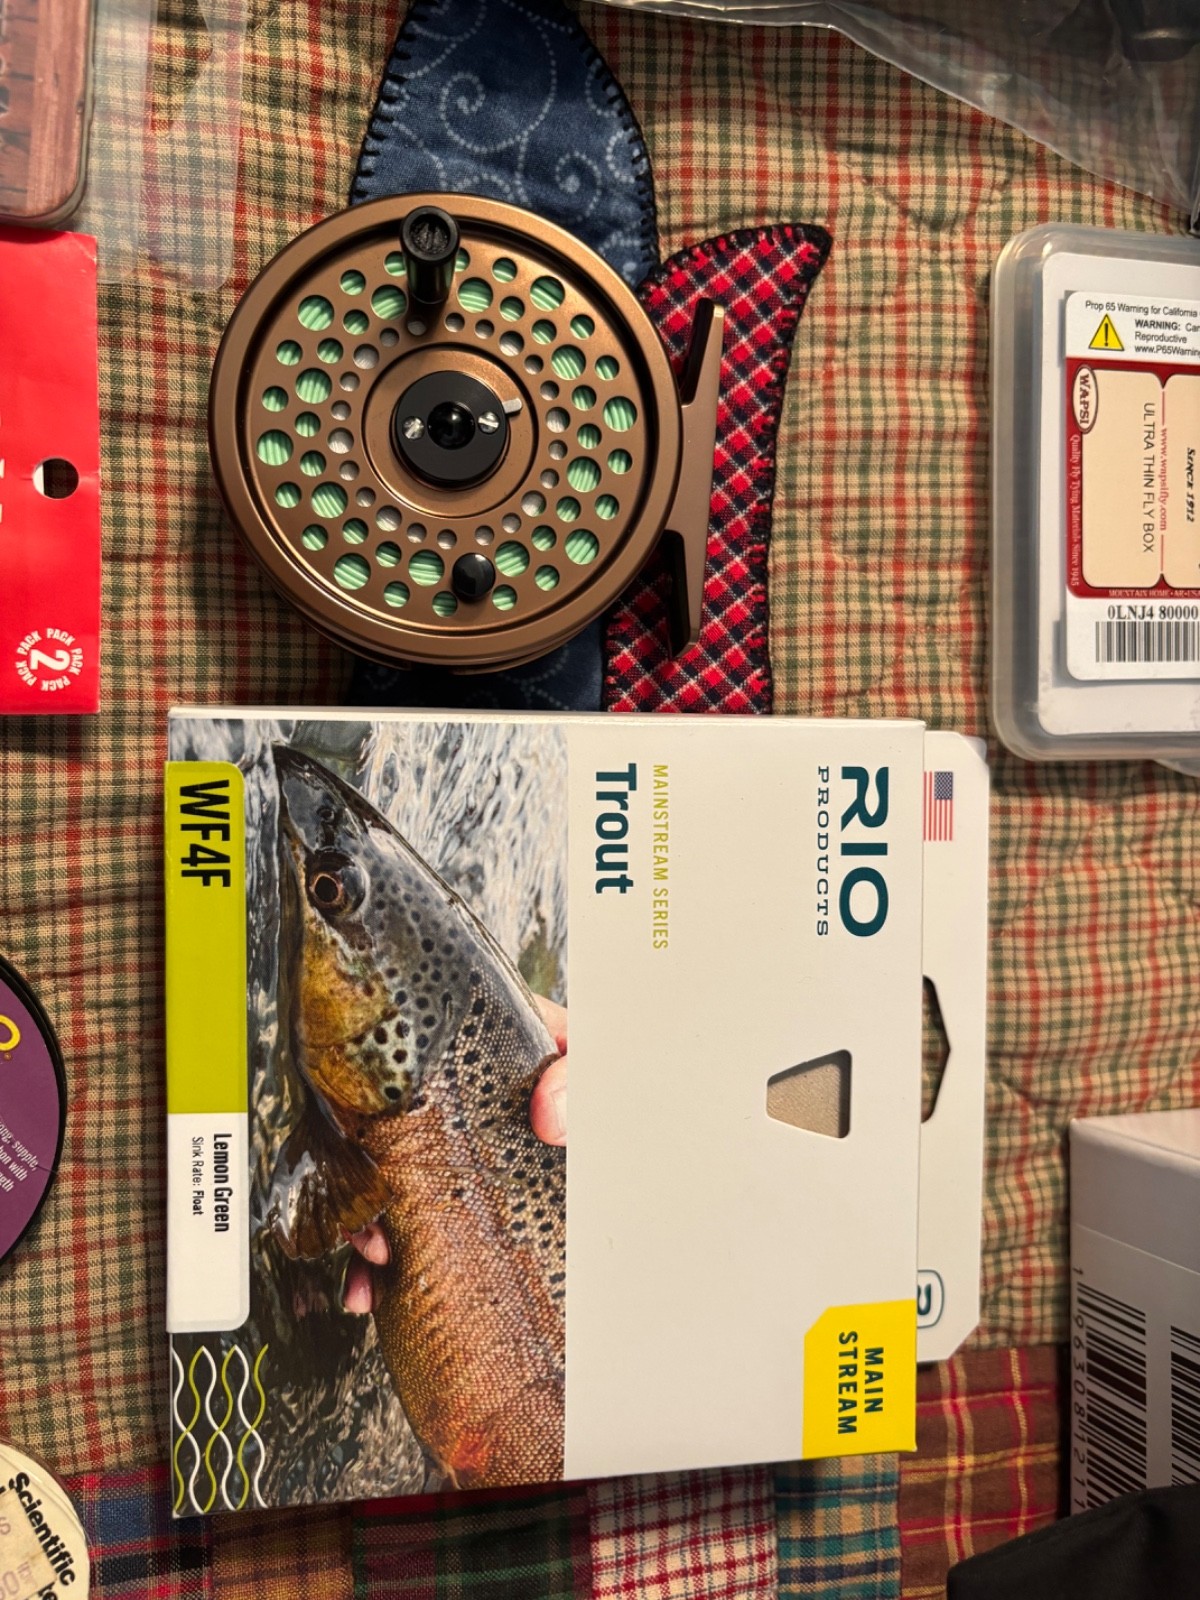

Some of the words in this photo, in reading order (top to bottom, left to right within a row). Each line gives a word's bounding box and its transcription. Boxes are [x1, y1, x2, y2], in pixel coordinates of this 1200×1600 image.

[1085, 300, 1104, 311] Prop
[1106, 302, 1116, 311] 65
[1118, 303, 1149, 315] Warning
[1151, 306, 1161, 314] for
[1163, 306, 1198, 318] California
[1134, 319, 1181, 331] WARNING:
[1134, 332, 1187, 344] Reproductive
[1079, 373, 1091, 425] WAPSI
[1143, 402, 1155, 451] ULTRA
[1070, 434, 1080, 463] Quality
[1070, 466, 1080, 479] Fly
[1143, 455, 1155, 488] THIN
[1158, 428, 1169, 531] www.wapsifly.com
[1070, 480, 1080, 504] Tying
[1143, 493, 1155, 519] FLY
[1185, 492, 1196, 522] 1912
[1143, 523, 1155, 553] BOX
[1070, 567, 1079, 586] 1945
[17, 631, 42, 655] PACK
[46, 628, 75, 646] PACK
[16, 660, 37, 686] PACK
[30, 649, 70, 671] 2
[69, 648, 83, 675] PACK
[41, 676, 71, 691] PACK
[180, 779, 231, 887] WF4F
[595, 763, 637, 894] Trout
[652, 765, 668, 881] MAINSTREAM
[817, 766, 829, 936] PRODUCTS
[839, 766, 889, 937] RIO
[652, 888, 668, 949] SERIES
[11, 1140, 39, 1172] supple,
[192, 1136, 204, 1158] Sink
[213, 1133, 232, 1184] Lemon
[8, 1161, 28, 1182] with
[192, 1160, 204, 1186] Rate:
[192, 1190, 204, 1216] Float
[213, 1187, 233, 1232] Green
[838, 1331, 858, 1434] STREAM
[864, 1347, 884, 1413] MAIN
[9, 1472, 76, 1586] Scientific
